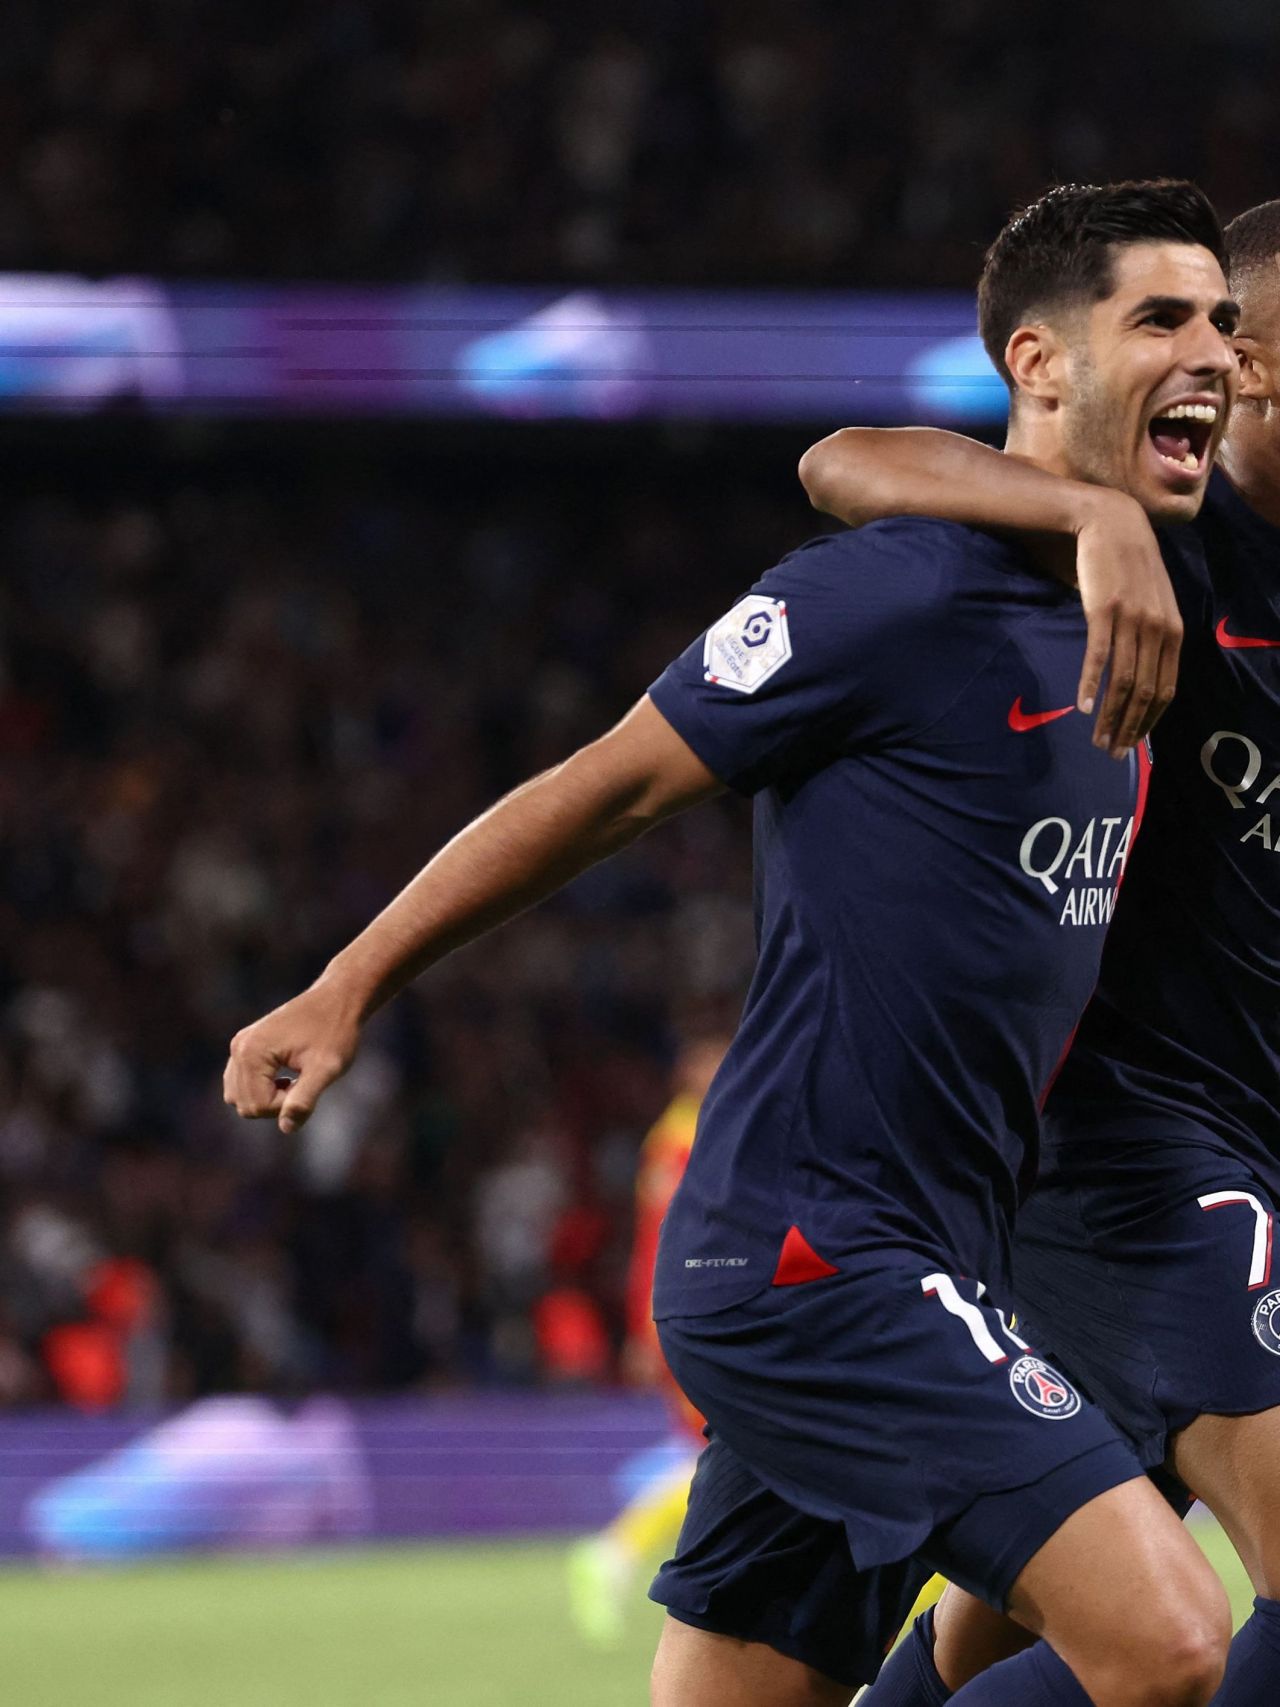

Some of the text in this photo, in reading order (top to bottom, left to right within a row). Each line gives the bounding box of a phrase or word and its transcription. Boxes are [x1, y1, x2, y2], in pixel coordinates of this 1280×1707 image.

[1019, 816, 1135, 895] QATA
[1059, 887, 1119, 926] AIRW
[1197, 1190, 1273, 1292] 7
[1013, 1360, 1047, 1384] PARIS
